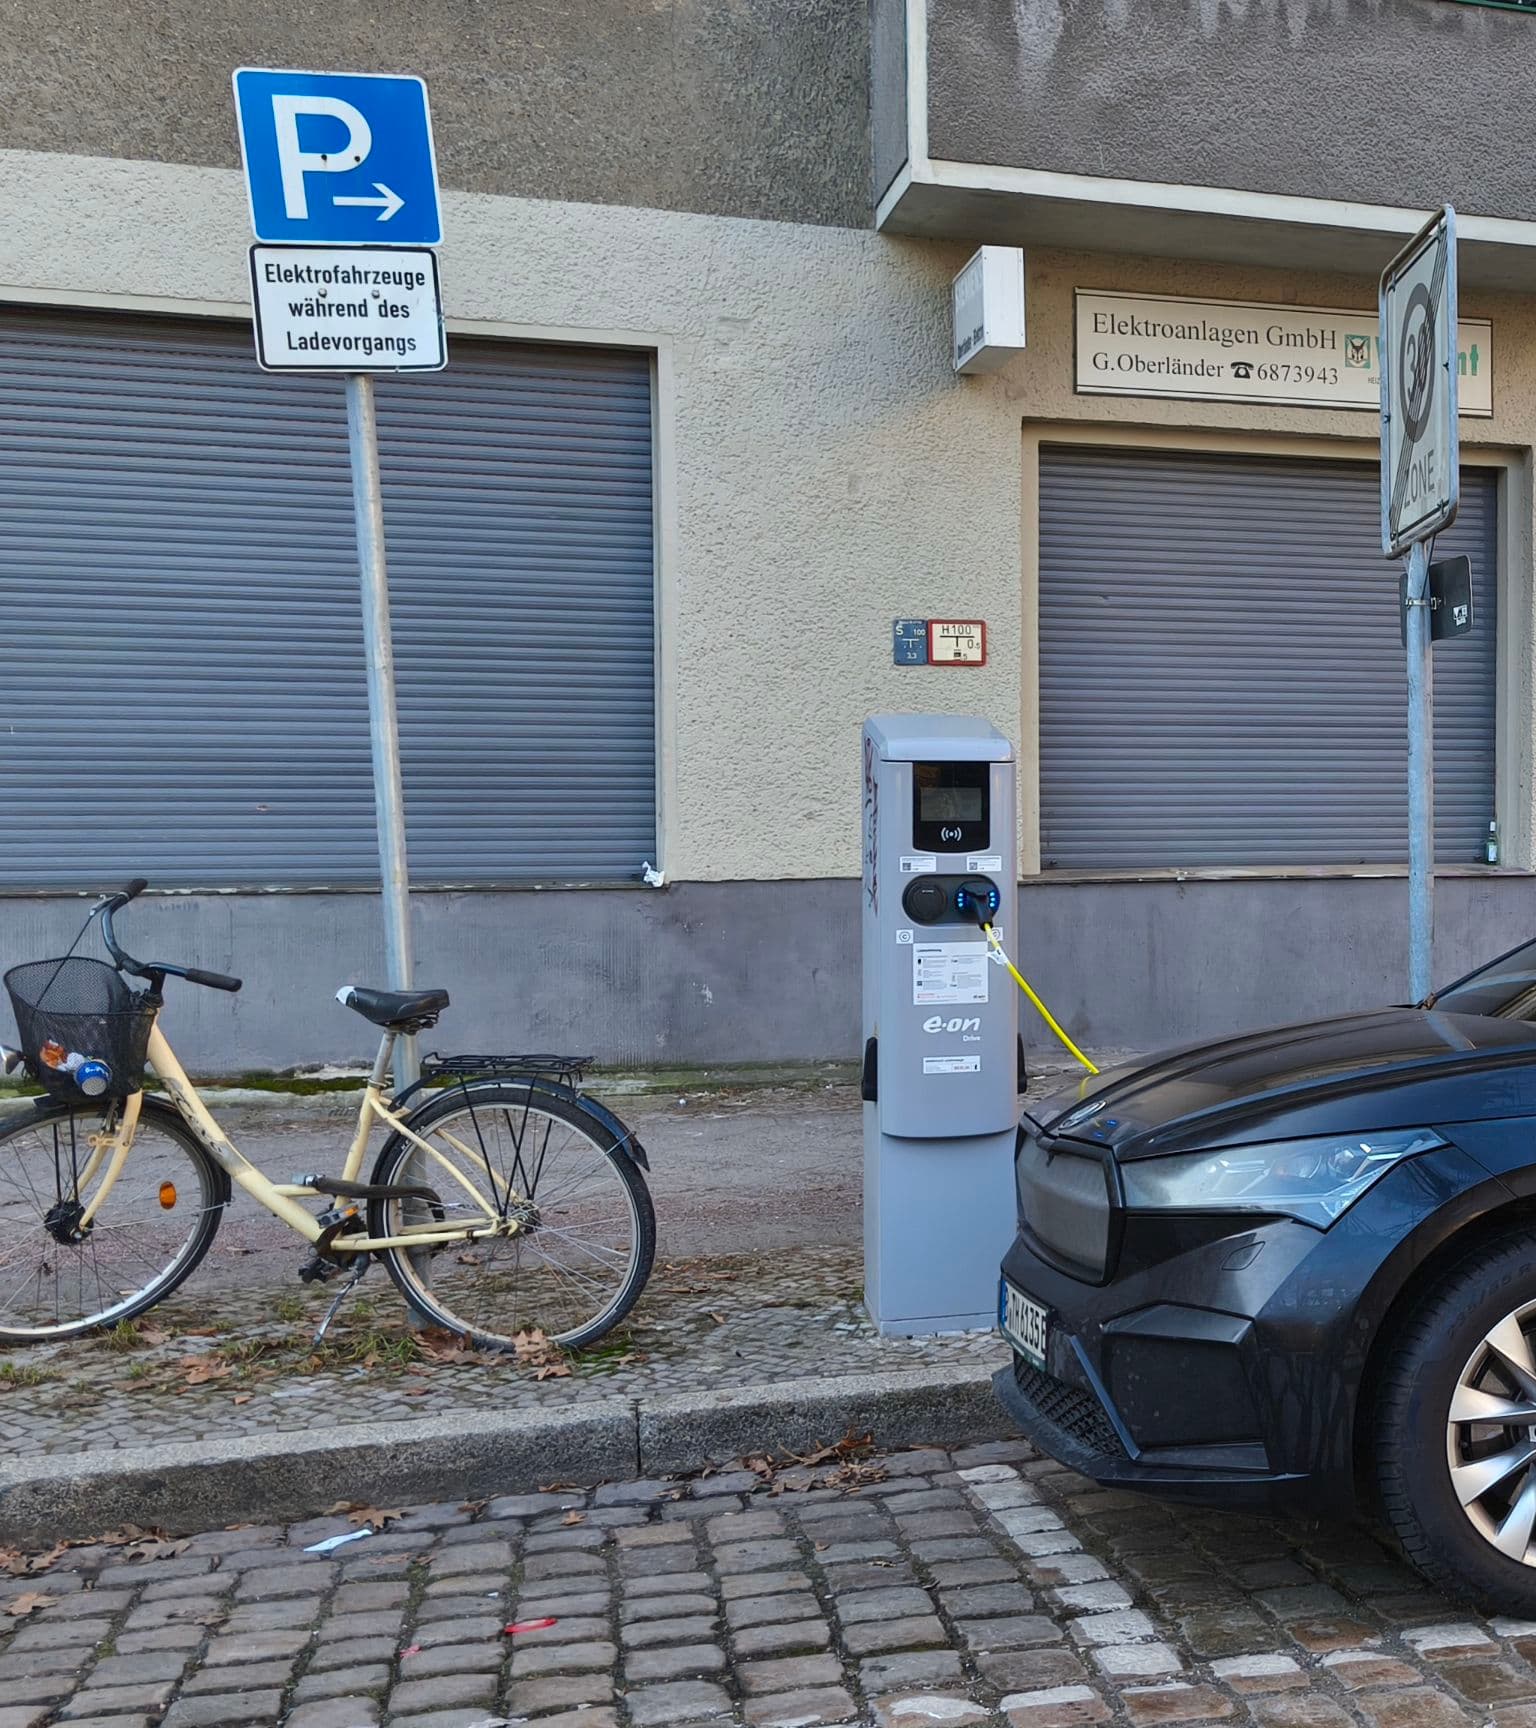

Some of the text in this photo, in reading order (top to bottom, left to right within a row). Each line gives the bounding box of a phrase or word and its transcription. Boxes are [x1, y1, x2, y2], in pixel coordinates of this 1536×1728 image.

[271, 94, 372, 219] P
[264, 263, 426, 290] Elektrofahrzeuge
[288, 297, 410, 319] während des
[286, 331, 417, 355] Ladevorgangs
[1093, 312, 1337, 350] Elektroanlagen GmbH
[1257, 362, 1339, 385] 6873943
[1403, 449, 1436, 508] ZONE
